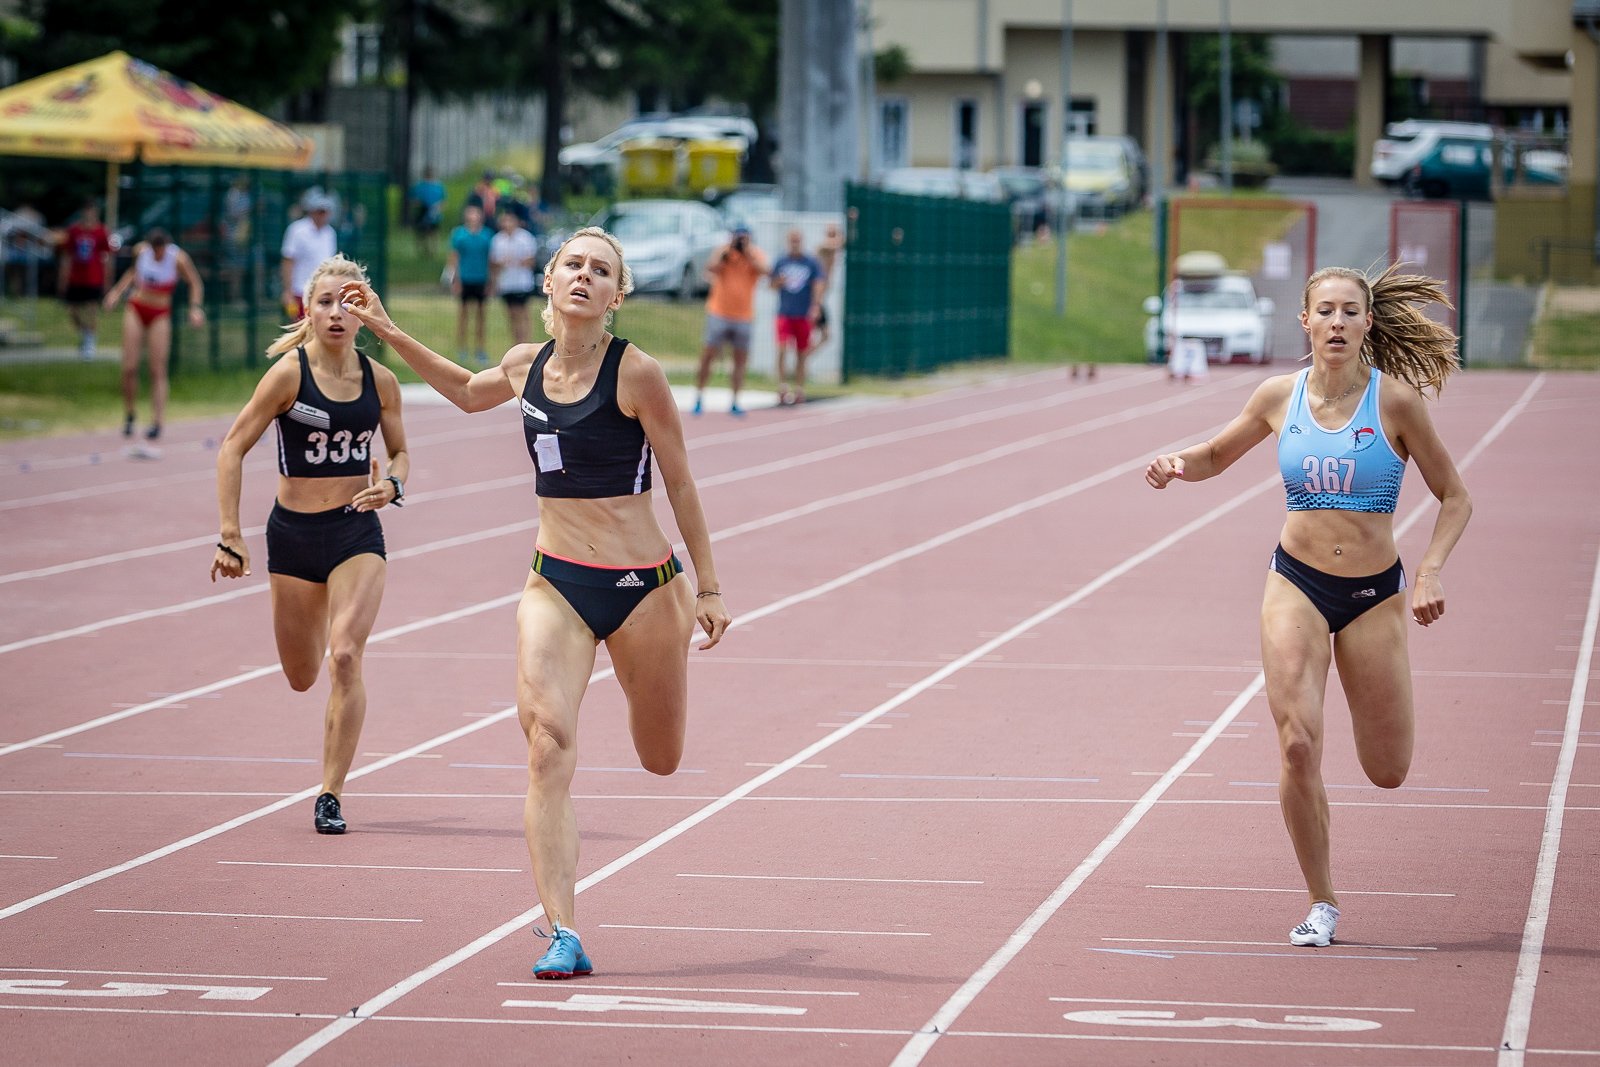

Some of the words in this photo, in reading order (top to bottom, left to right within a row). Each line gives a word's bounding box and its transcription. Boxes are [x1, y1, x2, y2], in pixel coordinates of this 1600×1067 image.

[305, 430, 373, 464] 333
[1302, 455, 1356, 494] 367
[1063, 1009, 1383, 1032] 3
